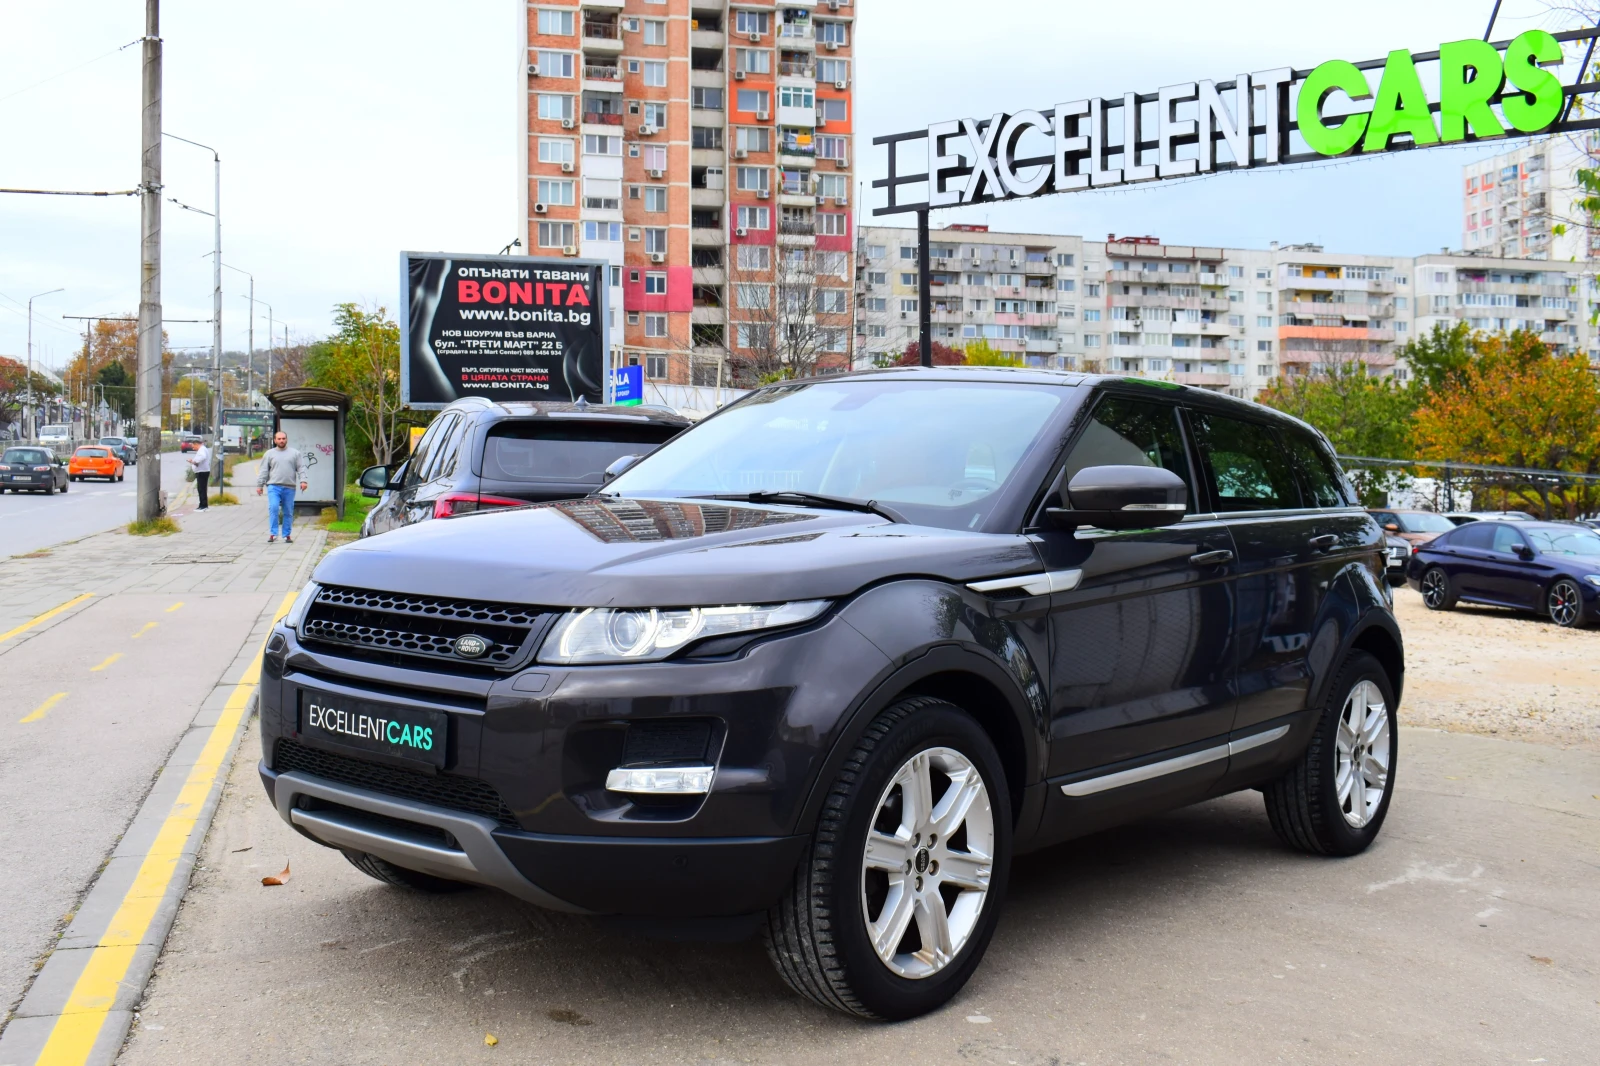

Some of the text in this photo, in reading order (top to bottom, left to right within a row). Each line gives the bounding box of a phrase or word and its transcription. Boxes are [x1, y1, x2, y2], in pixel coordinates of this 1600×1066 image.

[928, 30, 1564, 206] EXCELLENTCARS
[458, 267, 589, 281] опънати тавани
[458, 280, 590, 306] BONITA
[459, 308, 591, 326] www.bonita.bg
[464, 330, 503, 338] ШОУРУМ
[527, 331, 556, 339] ВАРНА
[435, 340, 457, 348] бул.
[541, 341, 553, 349] 22
[556, 341, 563, 349] Б
[462, 382, 550, 390] www.BONITA.bg
[460, 639, 477, 647] LAND
[461, 645, 480, 653] ROVER
[309, 704, 433, 750] EXCELLENTCARS
